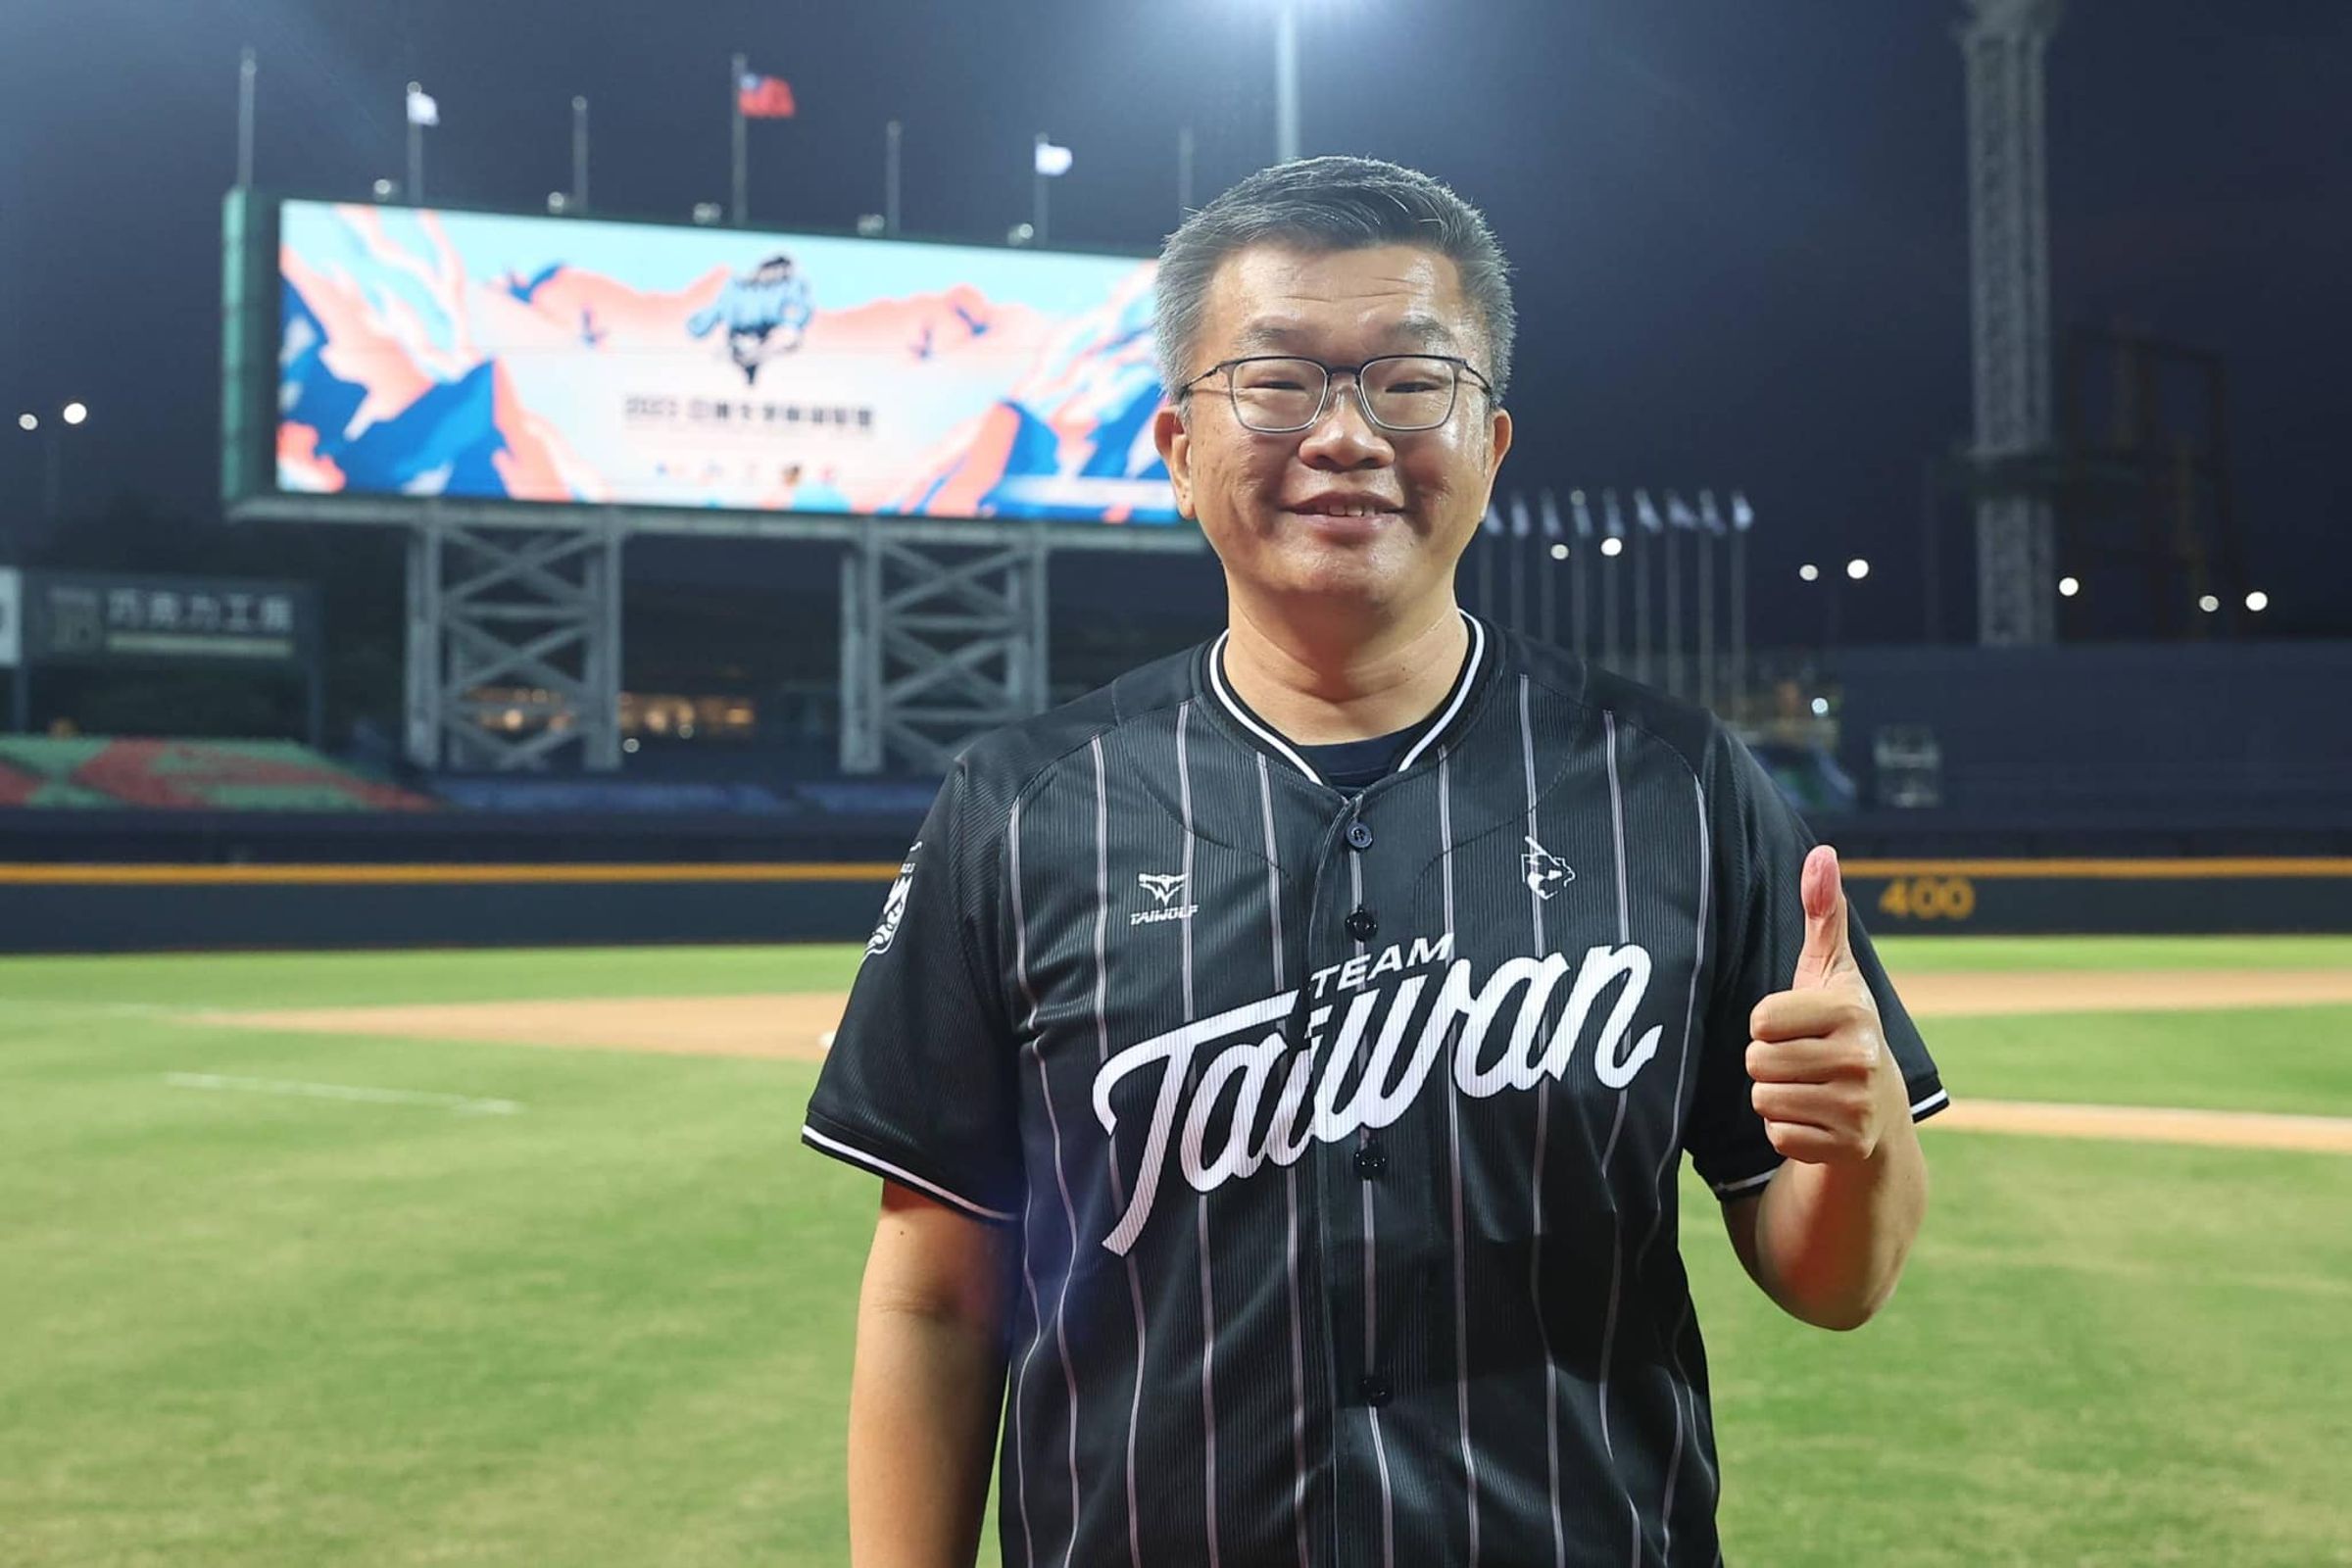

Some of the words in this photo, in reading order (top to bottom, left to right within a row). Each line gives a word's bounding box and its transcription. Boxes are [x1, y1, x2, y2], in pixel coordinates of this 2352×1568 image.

[1130, 905, 1199, 925] TAIWOLF
[1879, 878, 1976, 919] 400
[1310, 932, 1454, 1000] TEAM
[1093, 944, 1663, 1256] Taiwan
